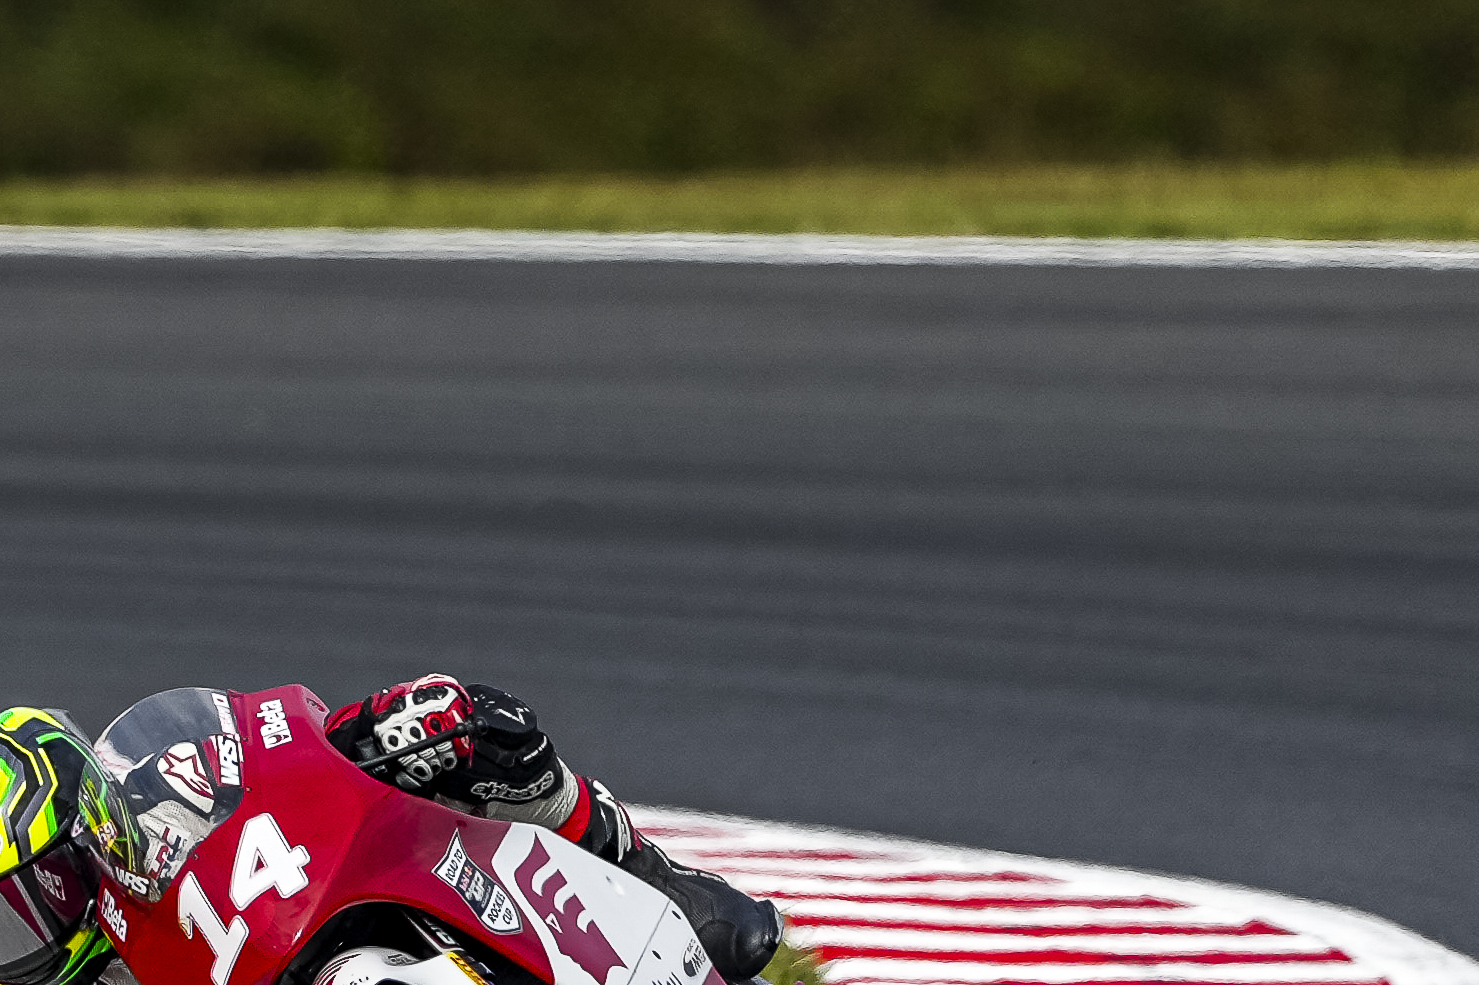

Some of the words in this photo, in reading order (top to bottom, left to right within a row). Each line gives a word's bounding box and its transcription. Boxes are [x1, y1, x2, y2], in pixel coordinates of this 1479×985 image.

[256, 699, 291, 738] Beta
[217, 735, 240, 786] WRS
[114, 865, 150, 895] WRS
[502, 907, 514, 925] CUP
